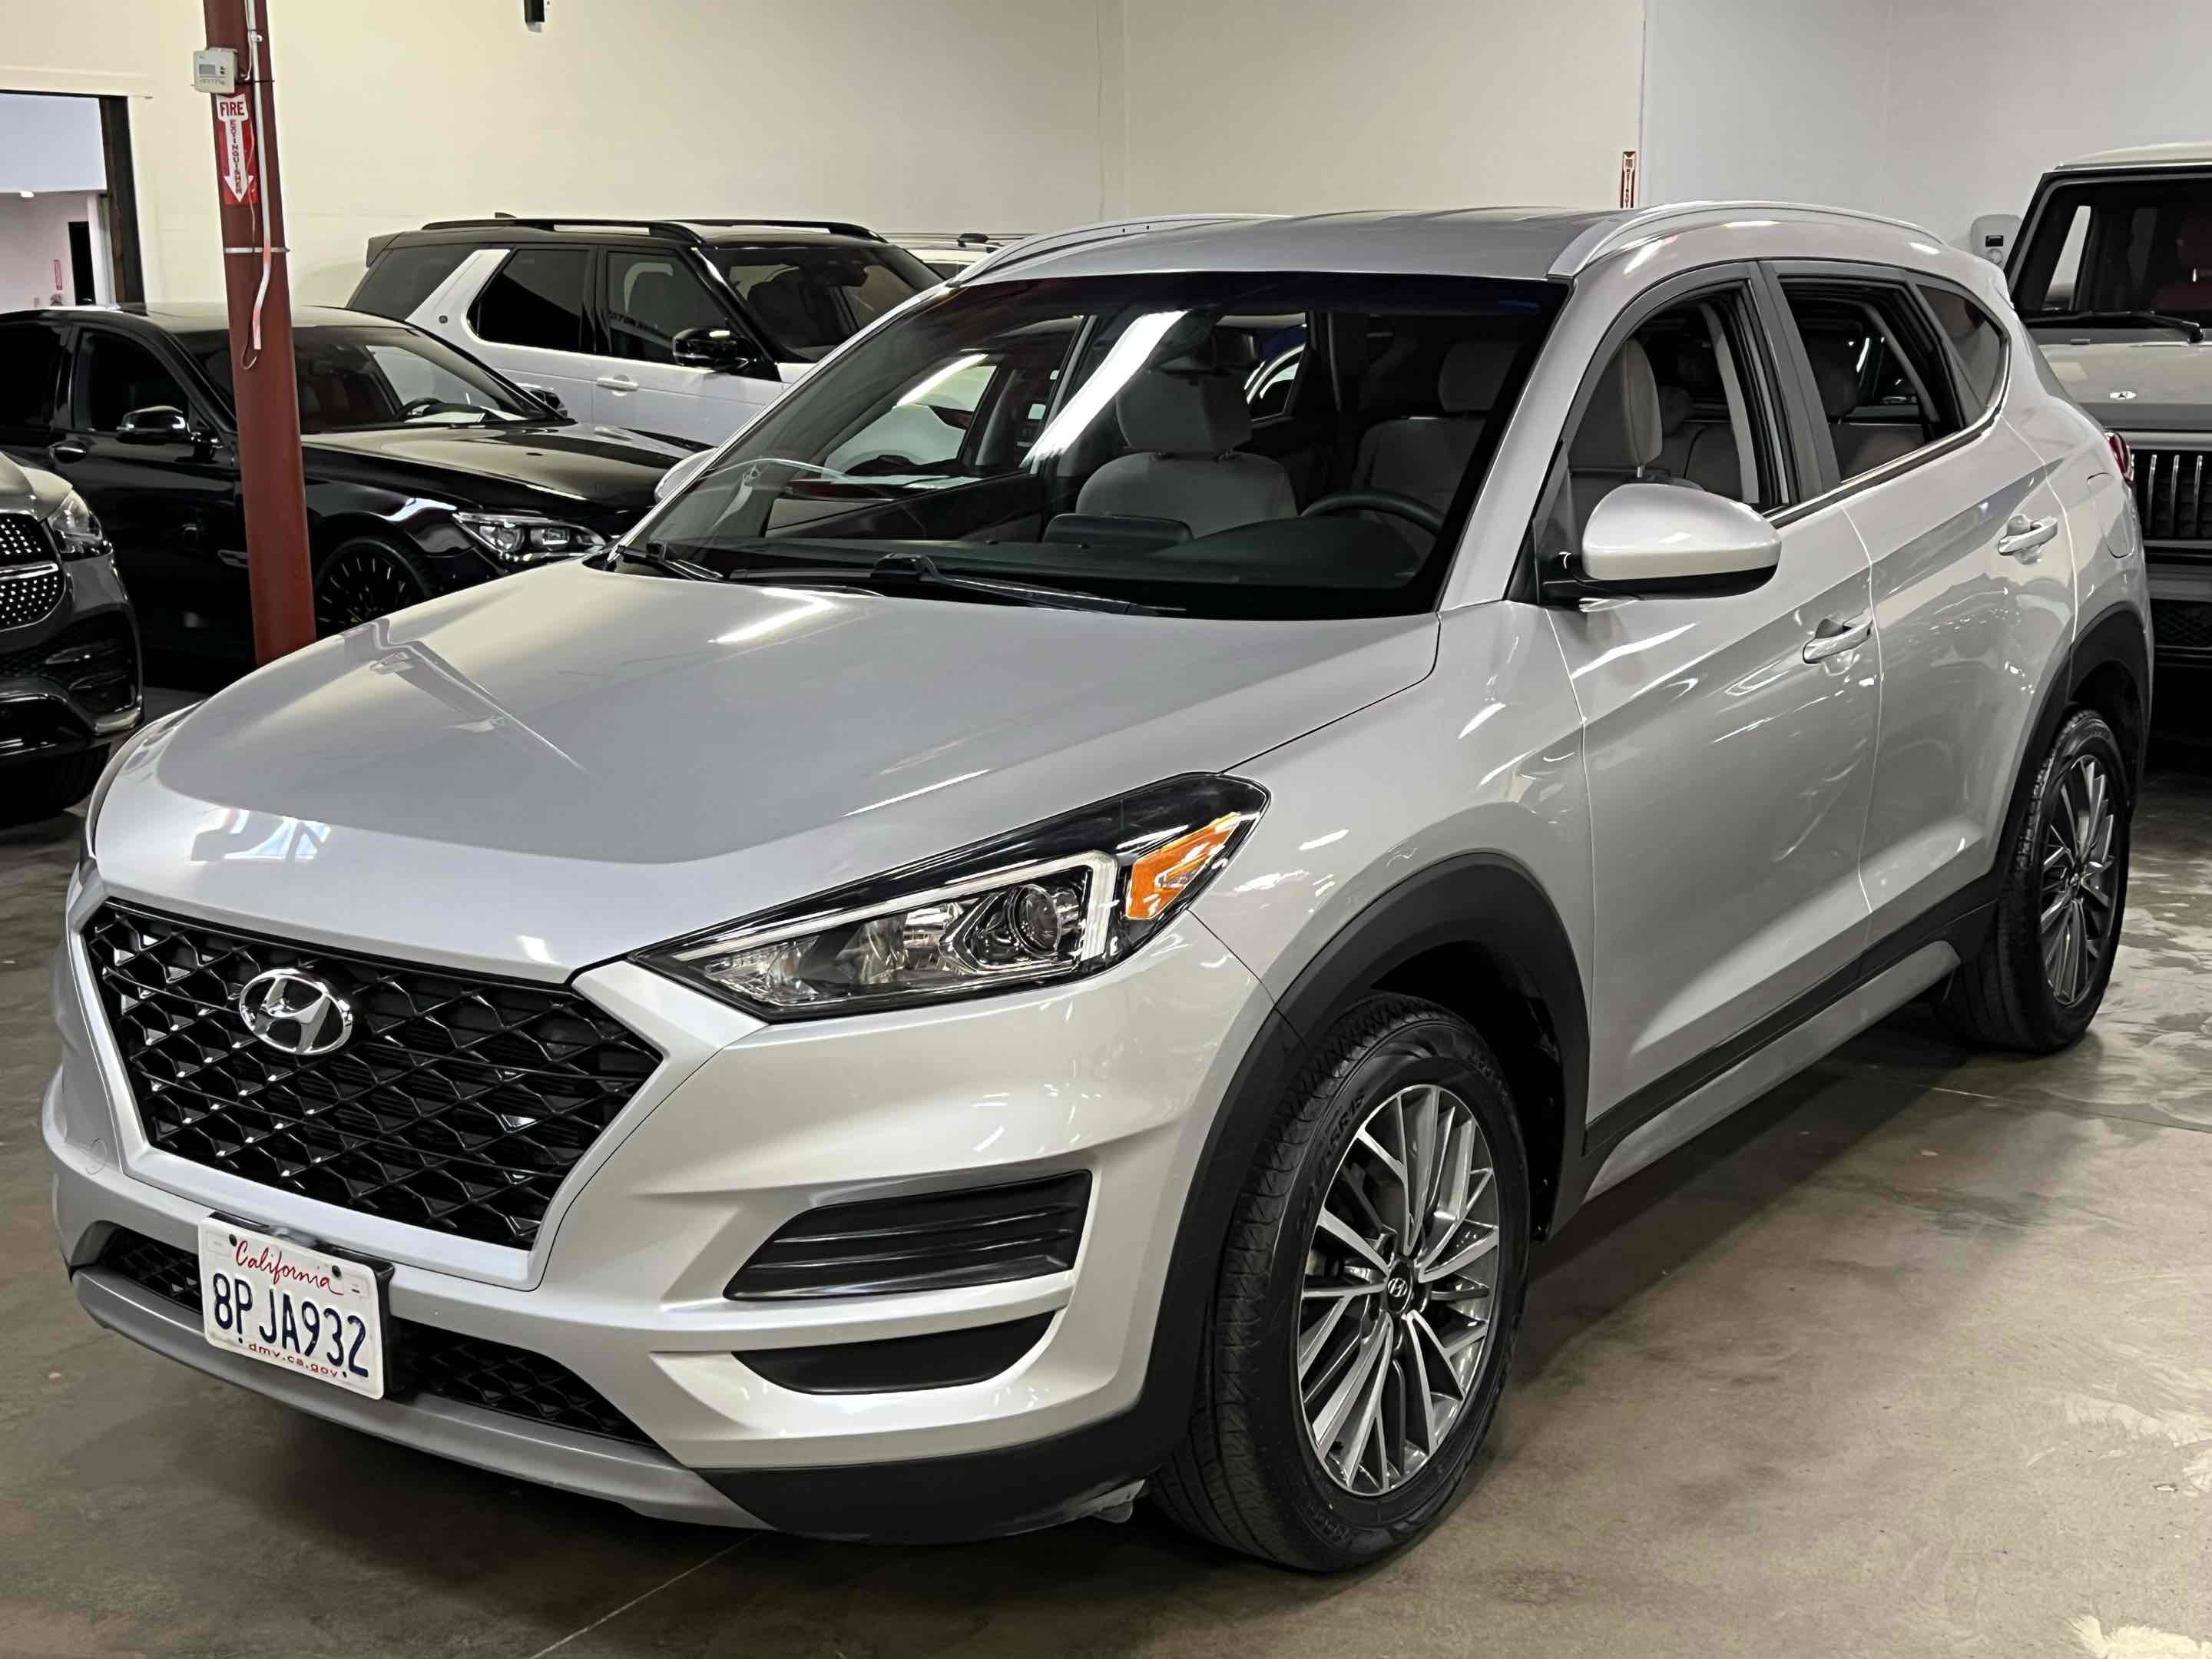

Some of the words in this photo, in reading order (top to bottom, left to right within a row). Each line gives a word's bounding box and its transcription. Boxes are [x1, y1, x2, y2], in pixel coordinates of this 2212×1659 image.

[219, 101, 245, 117] FIRE
[235, 1240, 344, 1296] California
[213, 1273, 369, 1377] 8PJA932
[249, 1343, 339, 1377] dmv.ca.gov
